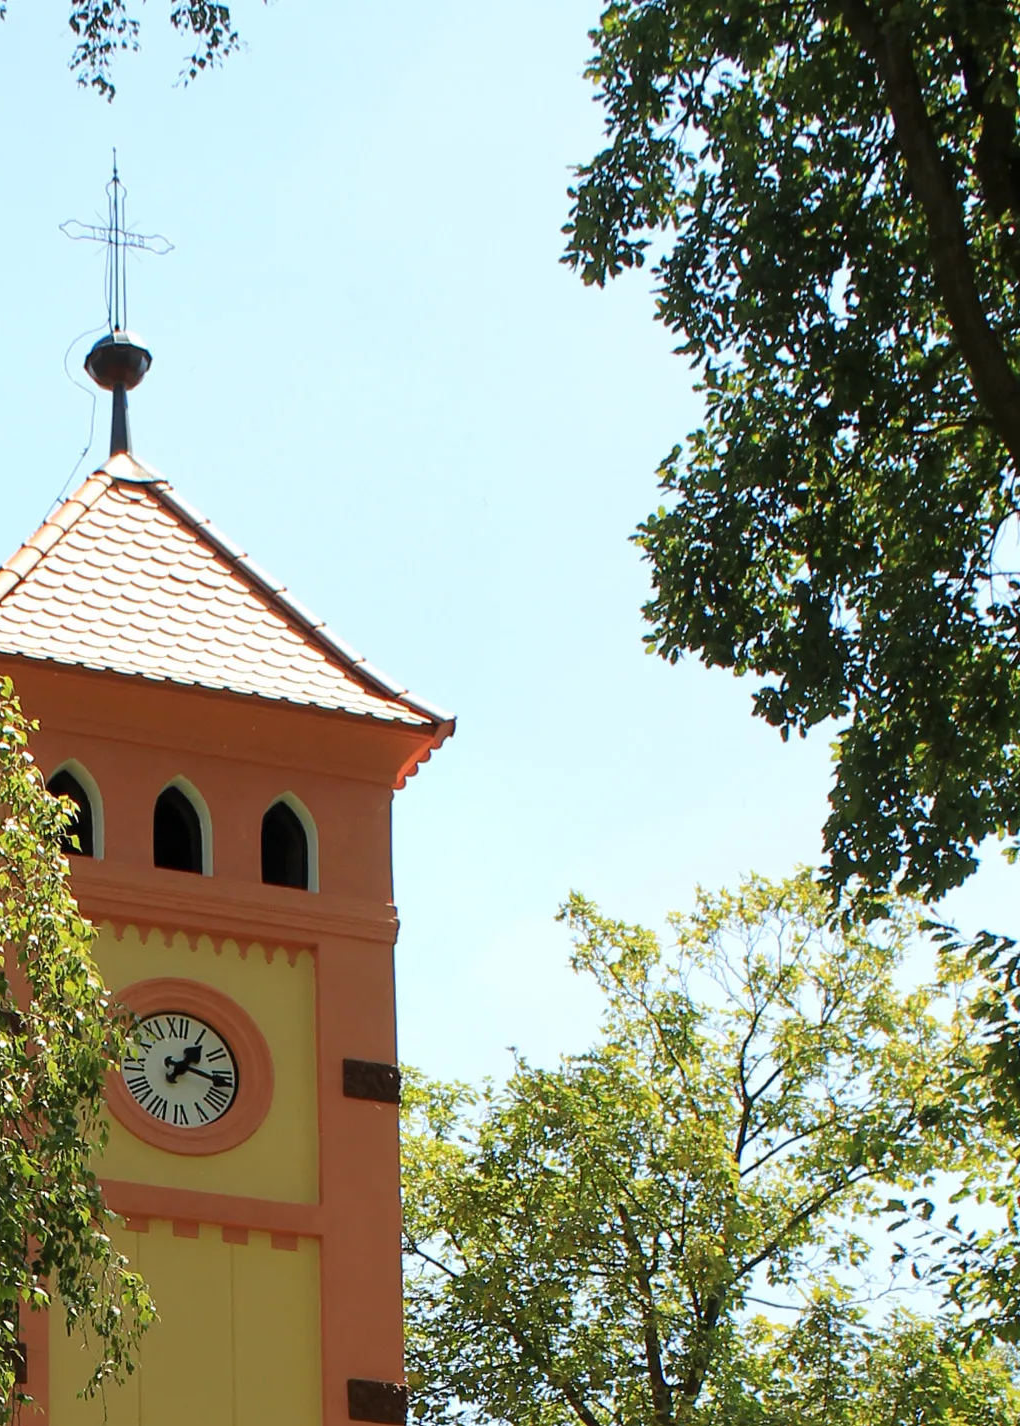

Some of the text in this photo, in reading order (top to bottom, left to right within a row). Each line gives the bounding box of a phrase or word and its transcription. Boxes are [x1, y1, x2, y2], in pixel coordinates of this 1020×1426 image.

[166, 1017, 190, 1040] XII
[205, 1047, 227, 1063] II
[127, 1075, 153, 1104] VIII
[203, 1086, 230, 1113] IIII
[146, 1095, 168, 1121] VII
[173, 1104, 189, 1126] VI
[194, 1102, 210, 1122] V
